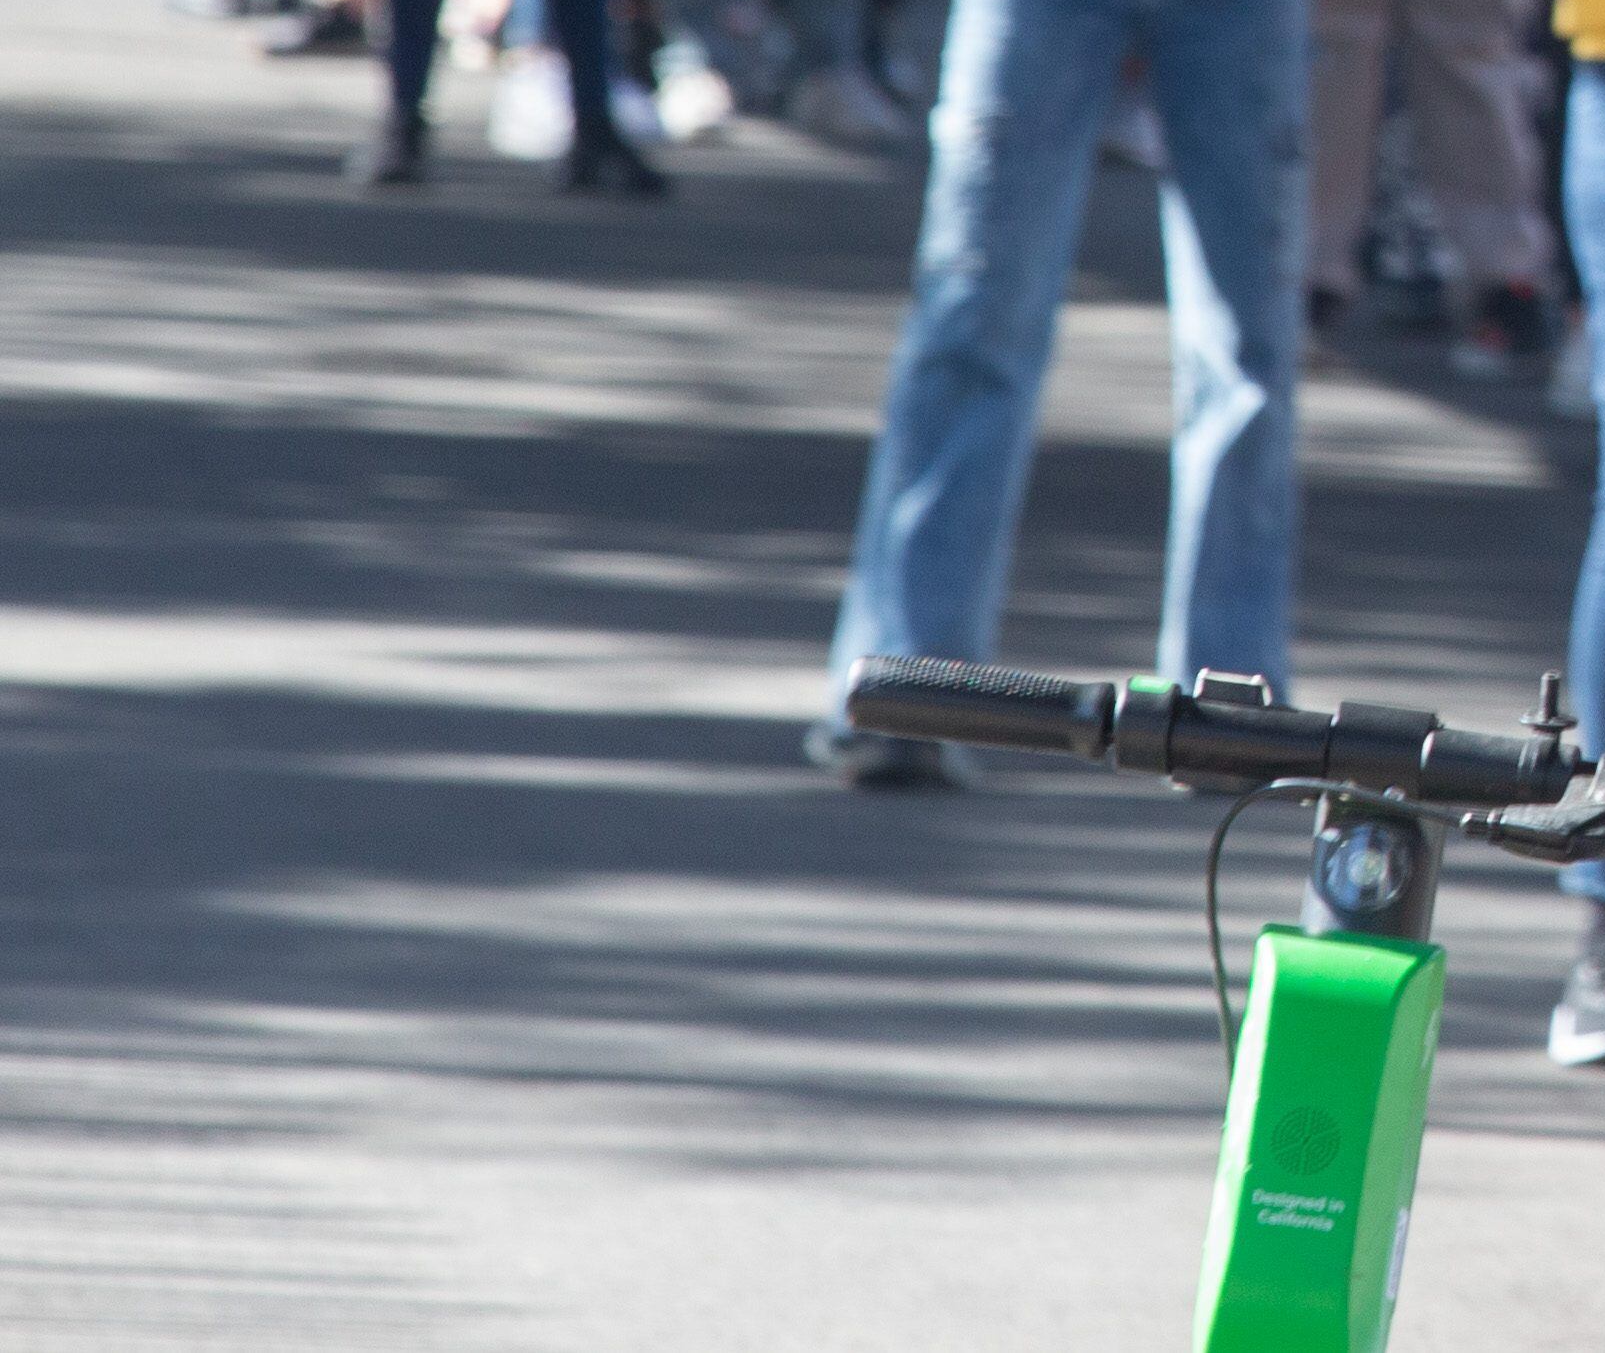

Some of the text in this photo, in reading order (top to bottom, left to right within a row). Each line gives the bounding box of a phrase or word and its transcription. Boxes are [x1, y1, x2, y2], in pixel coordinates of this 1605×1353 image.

[1251, 1188, 1346, 1214] Designed in
[1257, 1208, 1335, 1232] California
